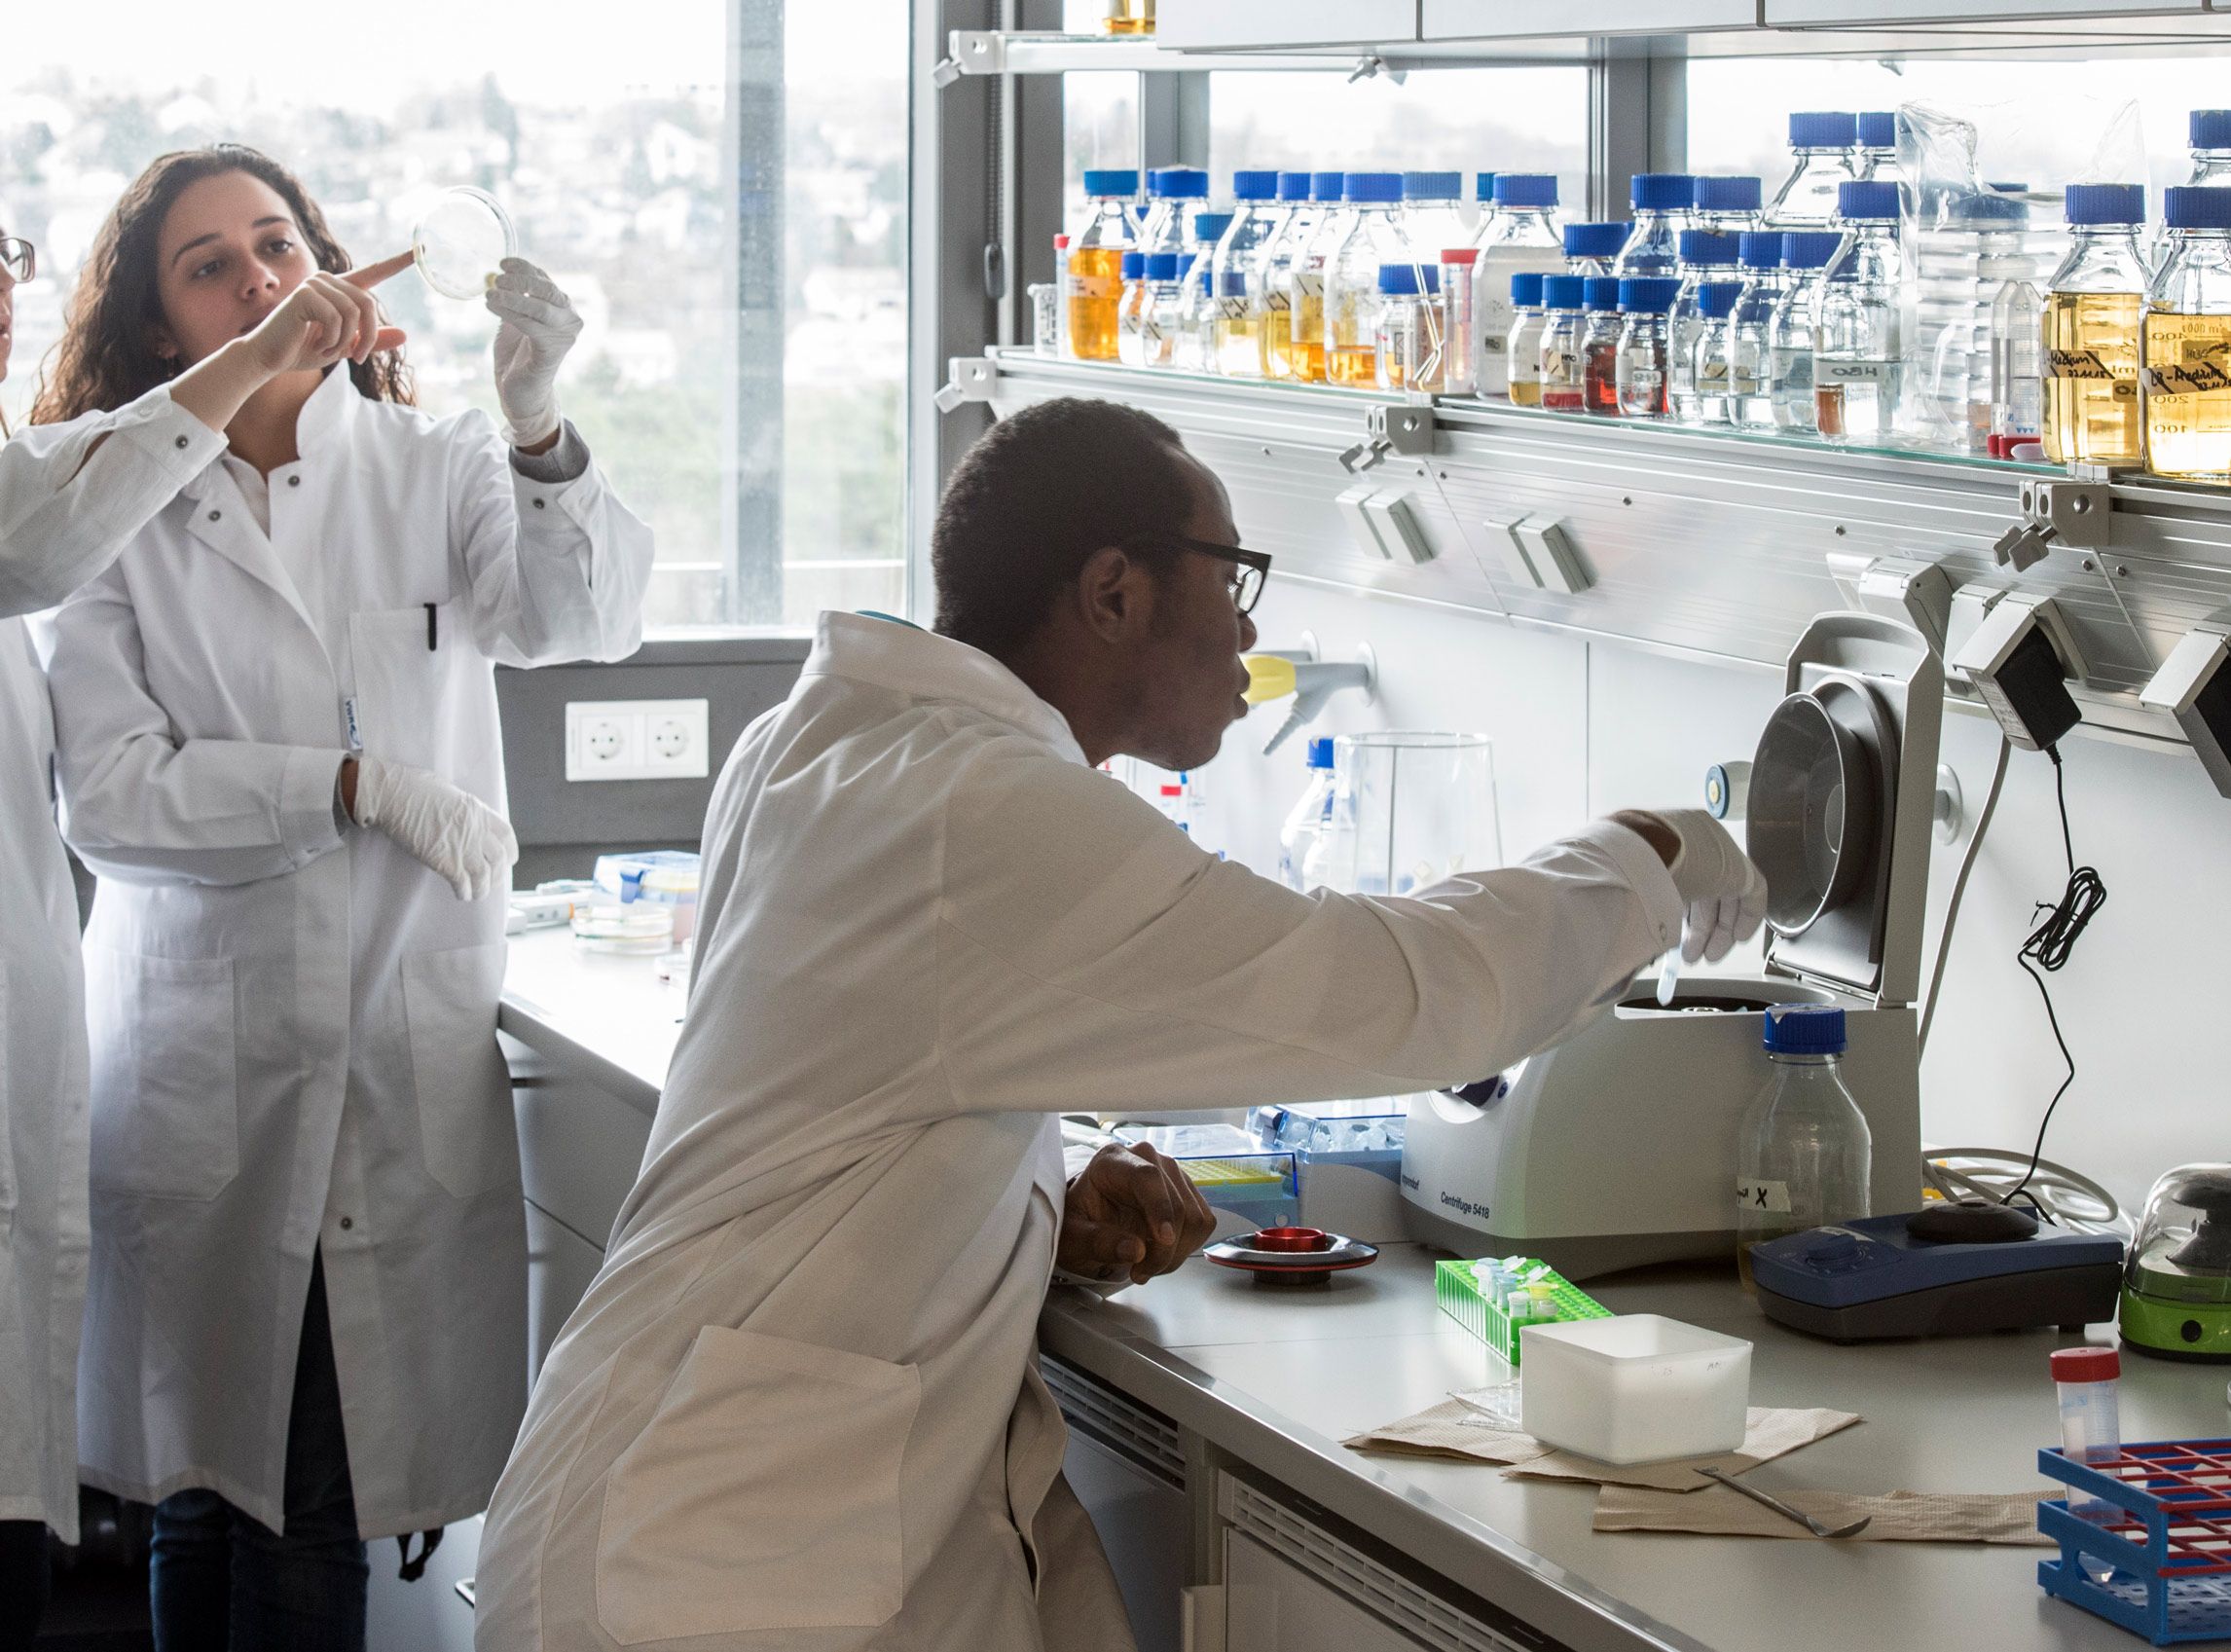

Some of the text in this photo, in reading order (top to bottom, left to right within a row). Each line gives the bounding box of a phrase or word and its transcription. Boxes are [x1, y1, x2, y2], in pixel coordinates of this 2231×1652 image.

[1441, 1191, 1490, 1219] Centrifuge 5418
[1755, 1187, 1768, 1209] X
